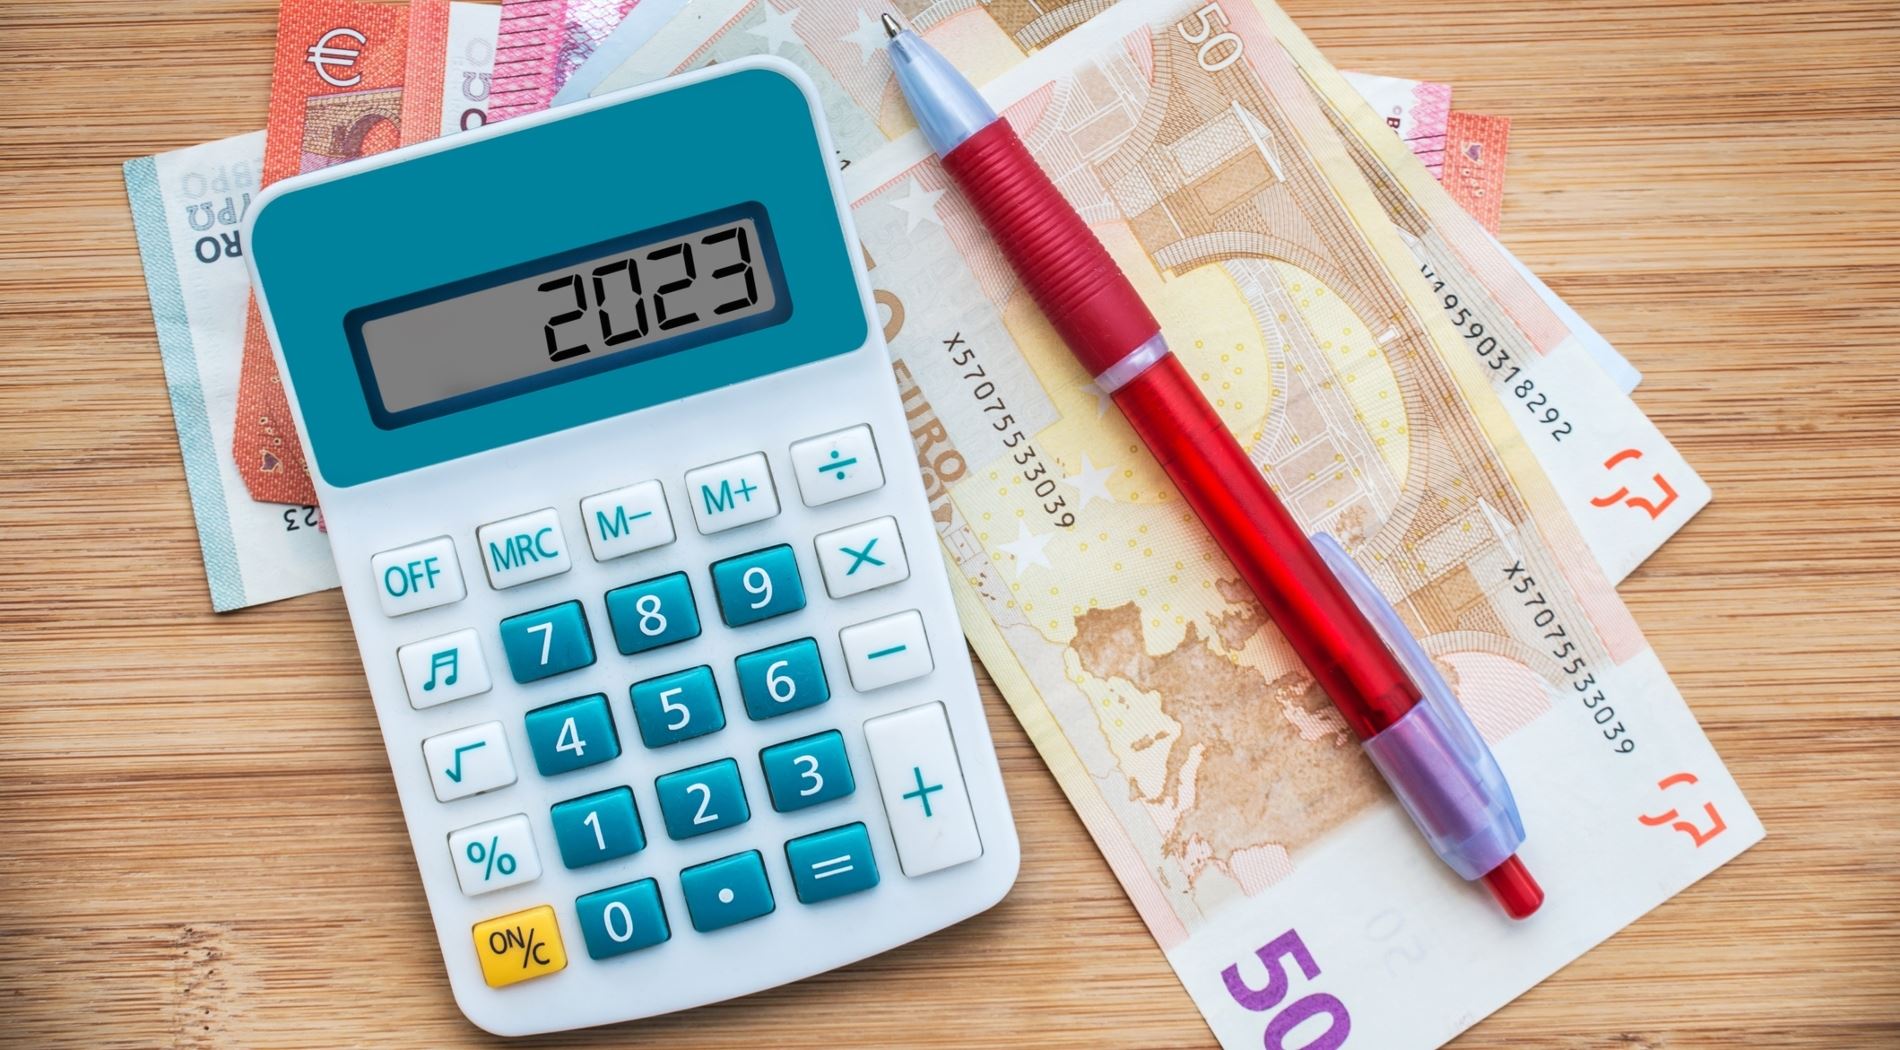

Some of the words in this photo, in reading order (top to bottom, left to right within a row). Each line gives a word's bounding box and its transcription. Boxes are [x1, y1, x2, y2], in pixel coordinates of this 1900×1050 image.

[1176, 1, 1244, 72] 50
[537, 226, 758, 362] 2023
[942, 331, 1076, 528] X57075533039
[700, 478, 758, 515] M+
[488, 526, 560, 573] MRC
[383, 556, 441, 598] OFF
[743, 567, 773, 609] 9
[636, 594, 667, 636] 8
[527, 622, 553, 665] 7
[1502, 560, 1636, 756] X57075533039
[766, 660, 796, 703] 6
[660, 687, 690, 731] 5
[555, 717, 586, 756] 4
[794, 755, 824, 796] 3
[686, 783, 718, 825] 2
[583, 811, 606, 850] 1
[465, 836, 518, 881] %
[603, 901, 634, 942] 0
[1221, 928, 1351, 1050] 50
